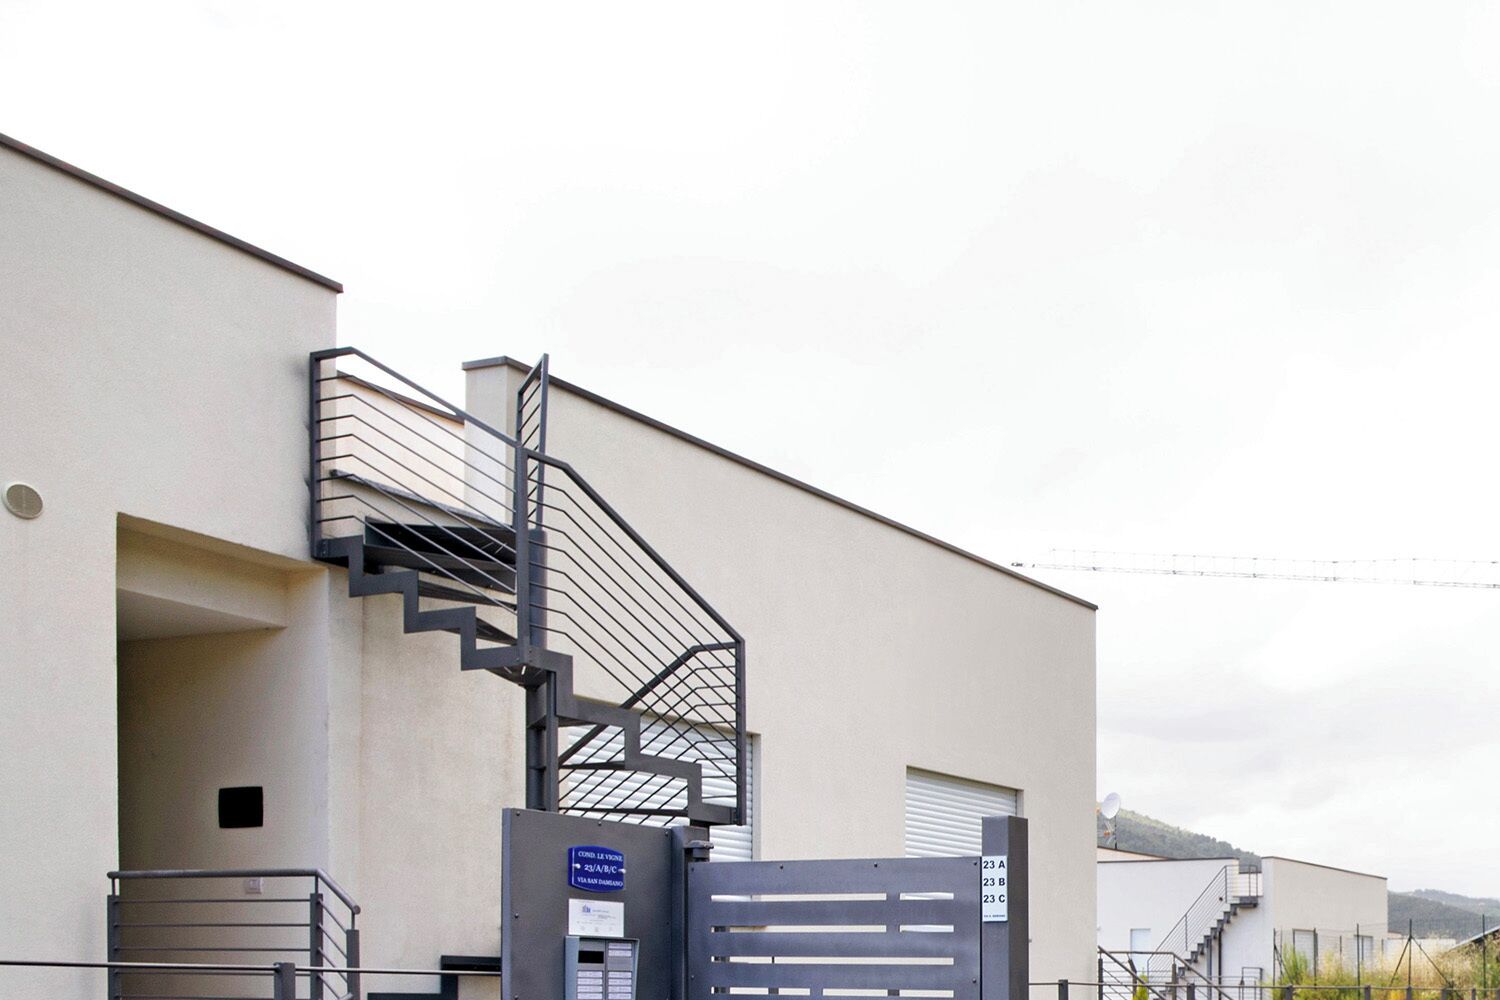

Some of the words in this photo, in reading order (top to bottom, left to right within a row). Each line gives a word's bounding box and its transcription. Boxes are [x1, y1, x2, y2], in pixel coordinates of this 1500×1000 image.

[605, 854, 623, 862] VIGNE
[584, 864, 617, 874] 23/A/B/C
[983, 860, 995, 869] 23
[998, 860, 1005, 869] A
[598, 879, 624, 888] DAMIANO
[983, 878, 995, 887] 23
[998, 878, 1005, 886] B
[983, 894, 995, 903] 23
[998, 894, 1005, 903] C
